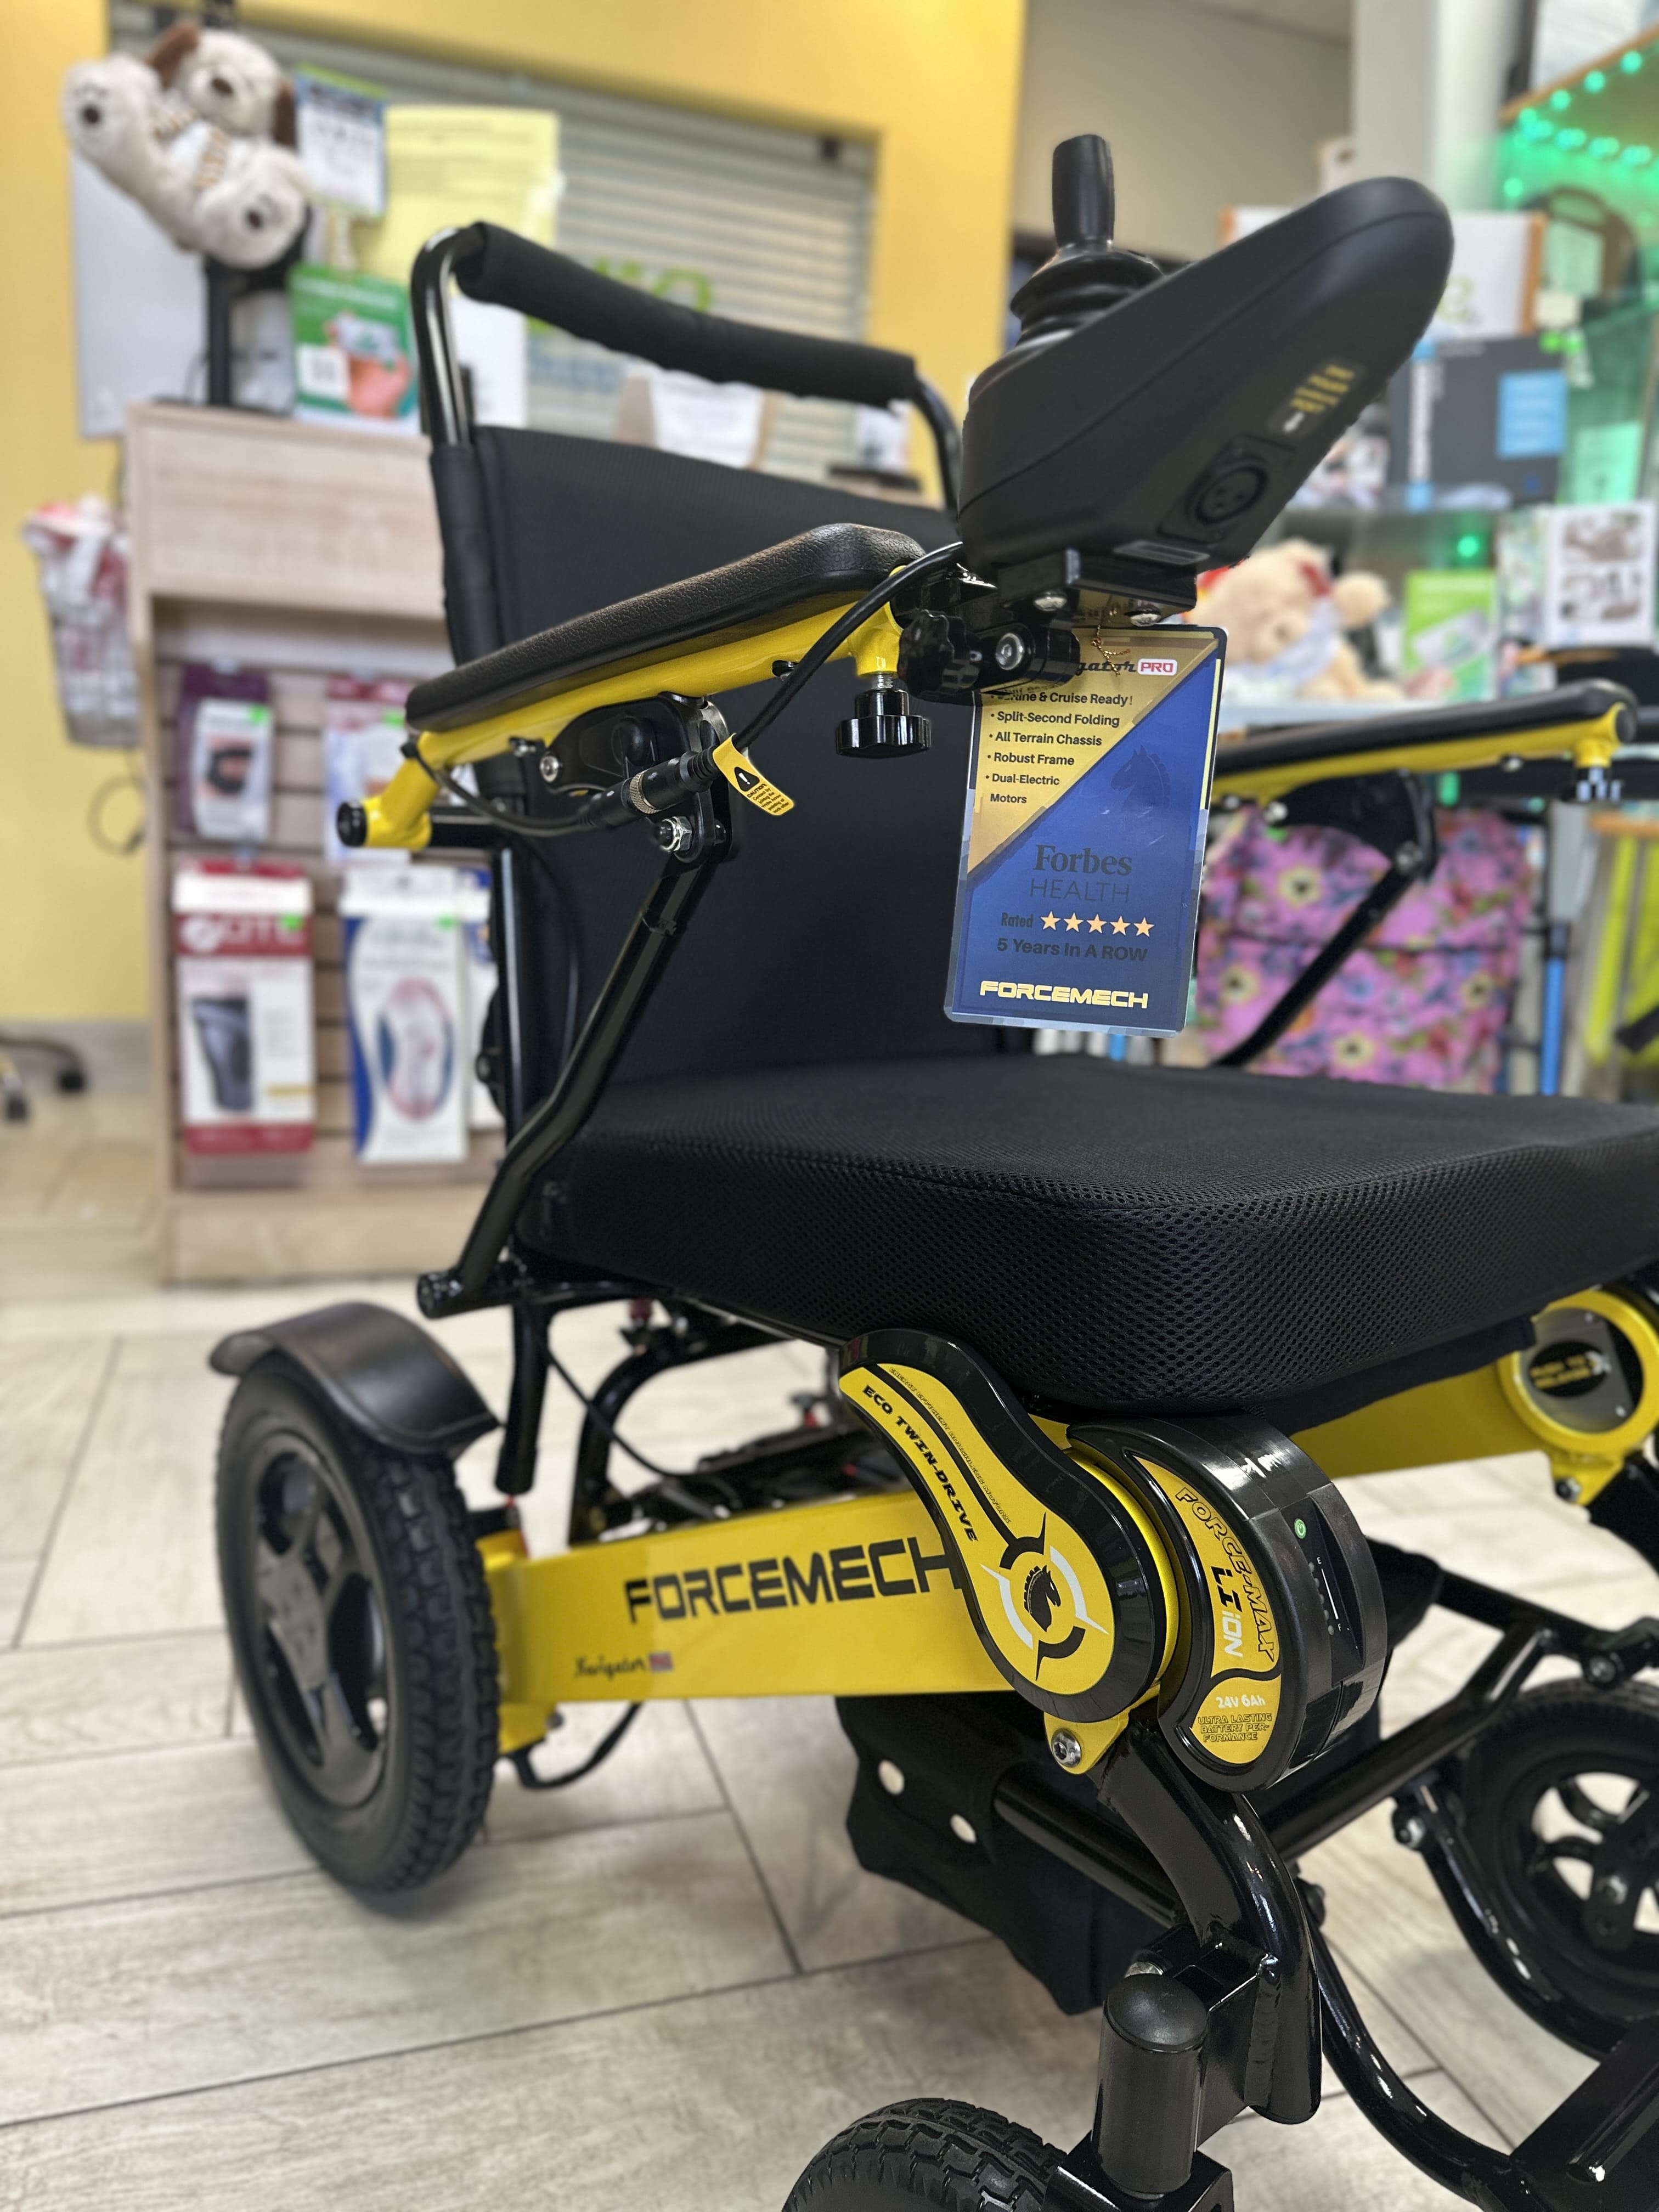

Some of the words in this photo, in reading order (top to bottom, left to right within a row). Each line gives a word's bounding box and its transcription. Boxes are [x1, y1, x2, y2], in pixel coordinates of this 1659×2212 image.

[1141, 662, 1174, 673] PRO
[1039, 692, 1047, 702] &
[1050, 692, 1087, 703] Cruise
[997, 711, 1072, 724] Split-Second
[1074, 714, 1120, 728] Folding
[995, 731, 1010, 742] All
[1013, 732, 1054, 744] Terrain
[1057, 734, 1102, 746] Chassis
[994, 752, 1035, 764] Robust
[1037, 754, 1075, 765] Frame
[992, 773, 1060, 786] Dual-Electric
[990, 793, 1027, 804] Motors
[1033, 844, 1133, 876] Forbes
[1029, 879, 1130, 903] HEALTH
[1001, 912, 1034, 928] Rated
[997, 938, 1008, 951] 5
[1012, 939, 1060, 955] Years
[1064, 943, 1081, 957] In
[1084, 944, 1098, 958] A
[1102, 945, 1148, 962] ROW
[980, 980, 1149, 1009] FORCEMECH
[862, 1384, 893, 1415] ECO
[895, 1415, 979, 1542] TWIN-DRIVE
[1317, 1556, 1322, 1565] E
[623, 1536, 963, 1625] FORCEMECH
[1175, 1487, 1274, 1663] FORCE-MAX
[1338, 1623, 1342, 1632] F
[1215, 1695, 1239, 1709] 24V
[1240, 1694, 1266, 1707] 6Ah
[1198, 1715, 1229, 1725] ULTRA
[1230, 1712, 1272, 1723] LASTING
[1200, 1723, 1244, 1734] BATTERY
[1245, 1722, 1270, 1731] PER-
[1203, 1731, 1258, 1743] FORMANCE
